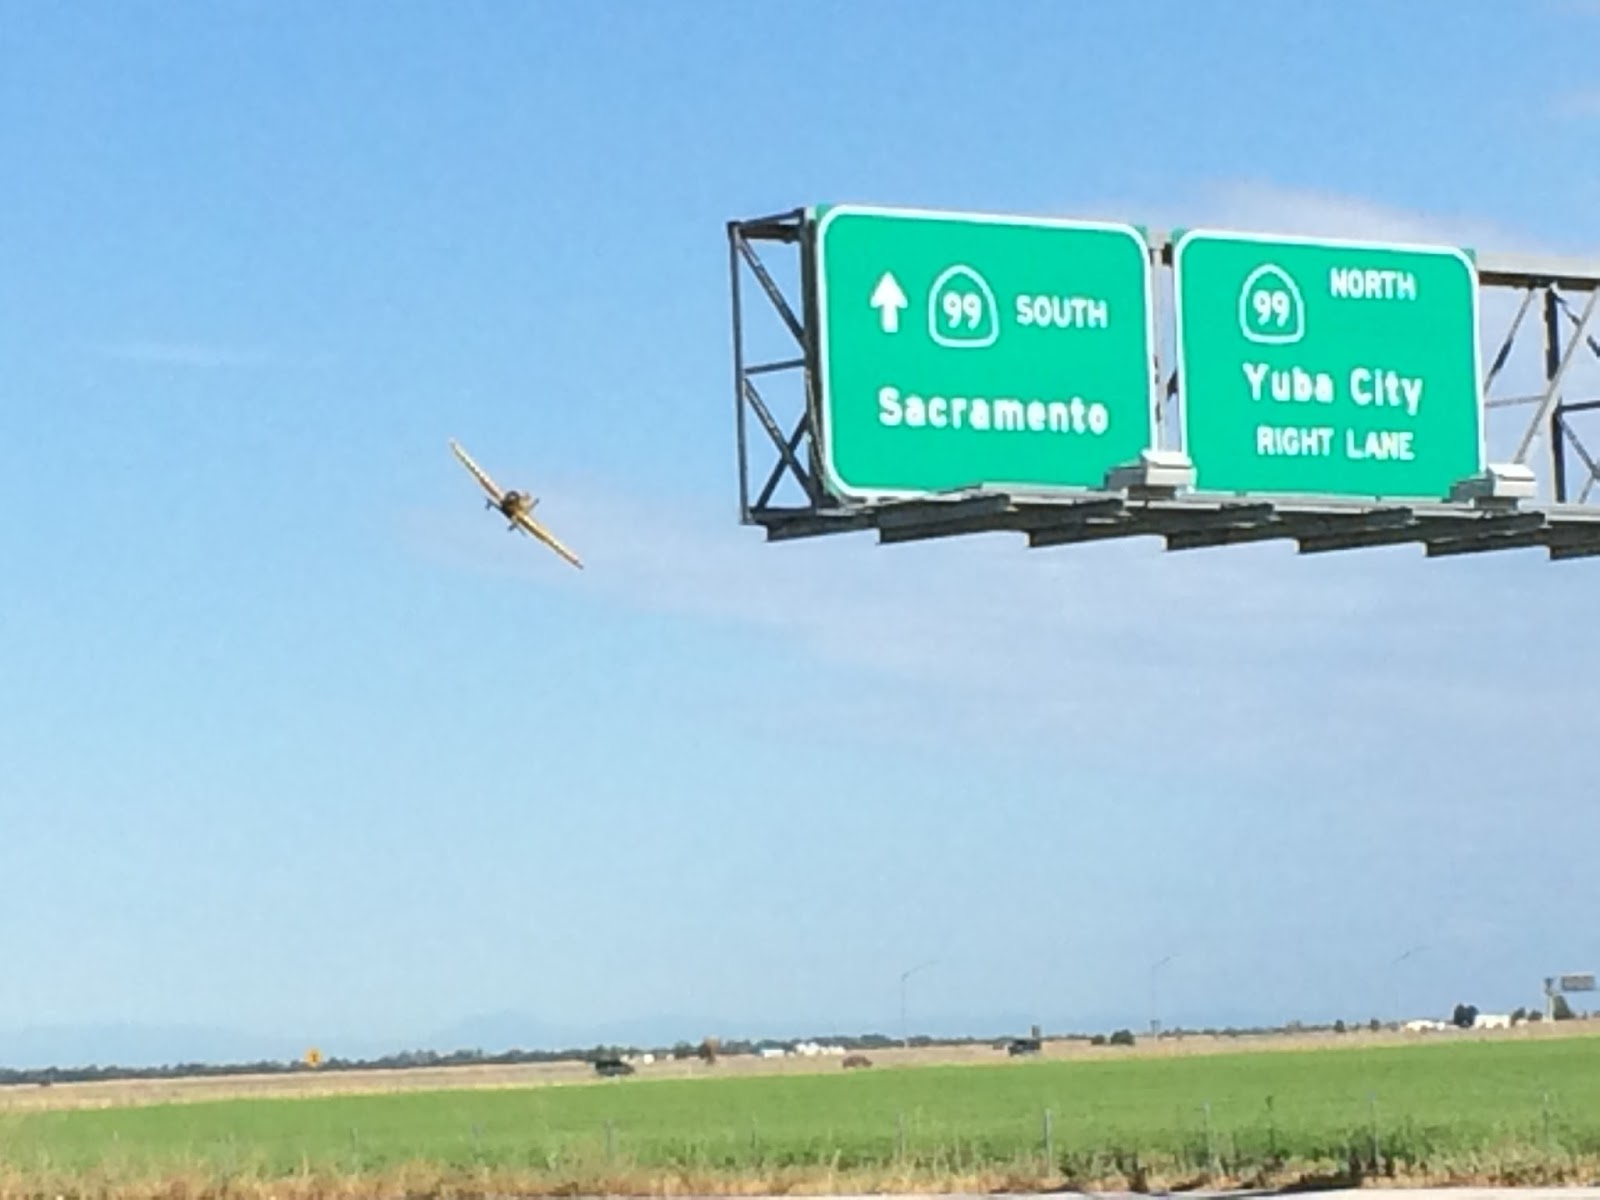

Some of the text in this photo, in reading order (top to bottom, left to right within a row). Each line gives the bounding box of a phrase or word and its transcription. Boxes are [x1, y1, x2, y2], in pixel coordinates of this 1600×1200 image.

[1330, 268, 1416, 301] NORTH
[943, 292, 1108, 330] 99 SOUTH
[1253, 290, 1291, 327] 99
[1242, 362, 1423, 414] Yuba City
[878, 386, 1109, 435] Sacramento
[1256, 425, 1415, 461] RIGHT LANE
